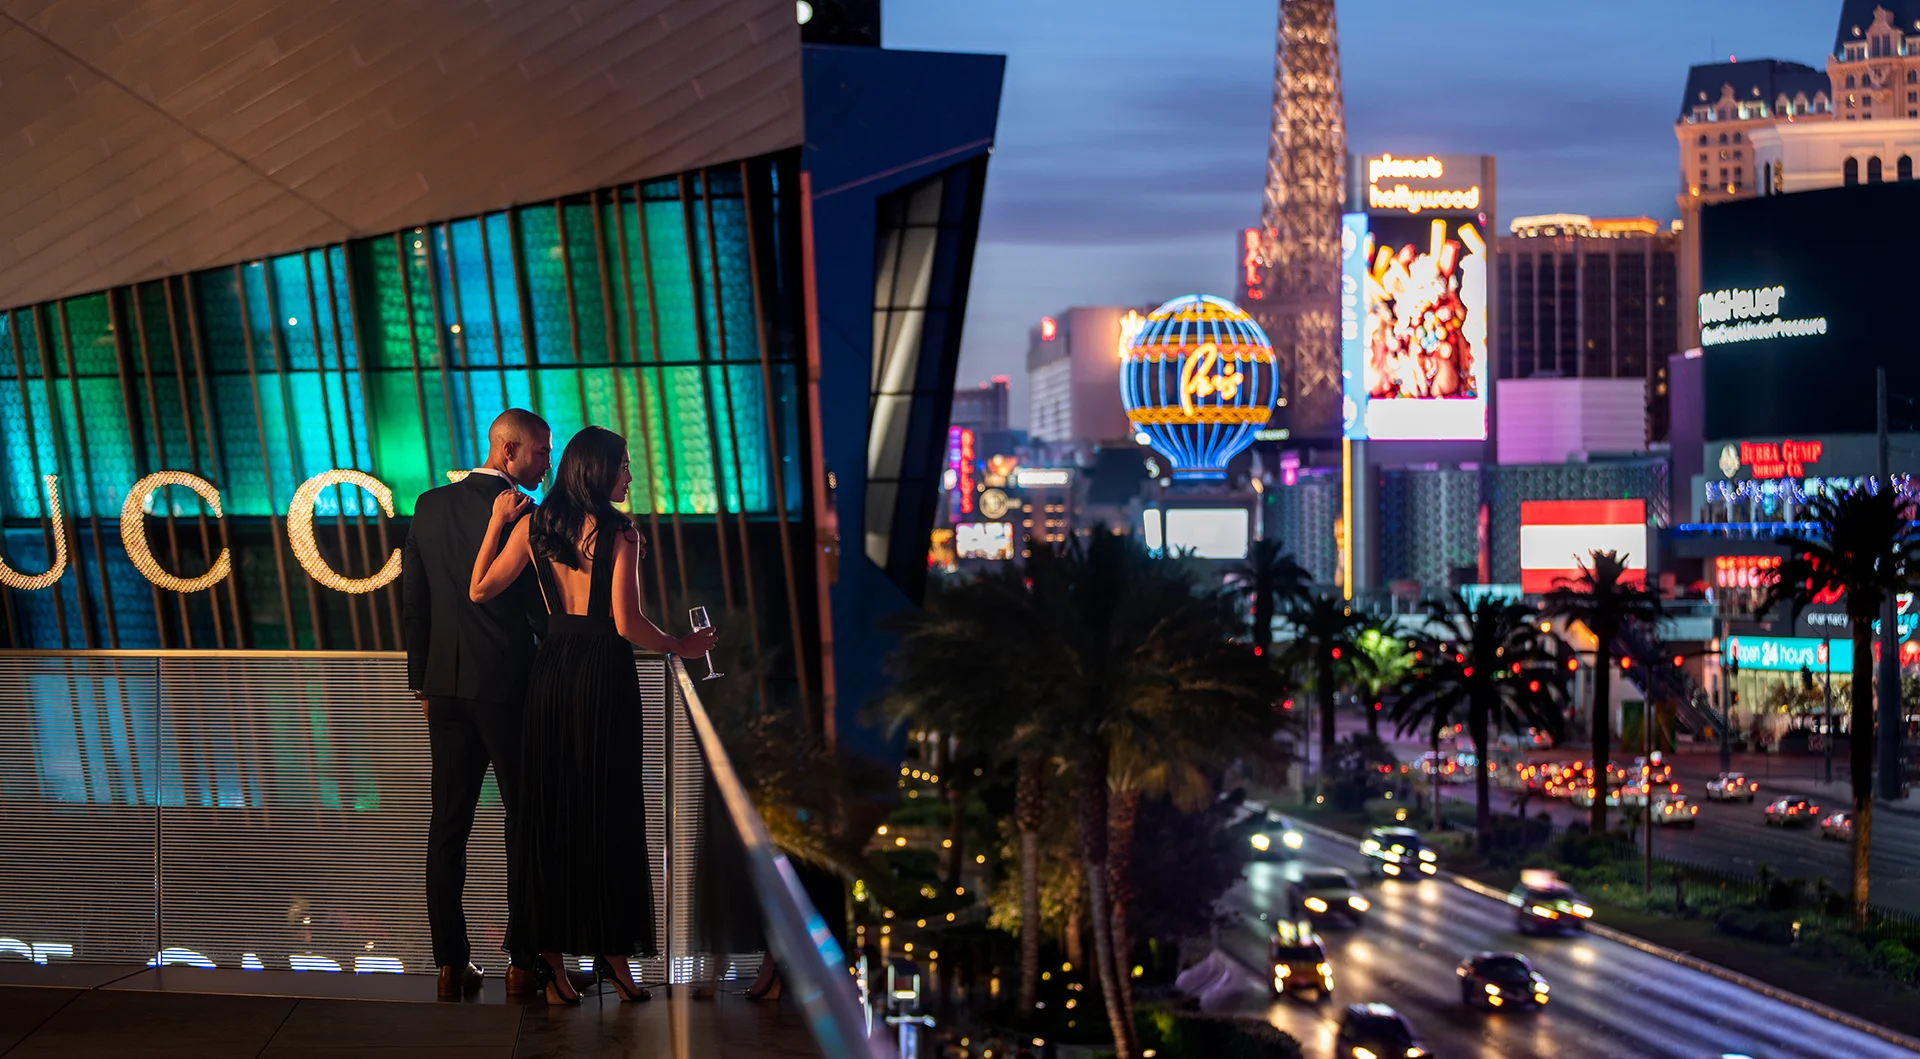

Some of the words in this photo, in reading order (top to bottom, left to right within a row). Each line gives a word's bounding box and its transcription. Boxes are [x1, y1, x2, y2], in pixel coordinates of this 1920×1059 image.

[1369, 153, 1443, 183] planet
[1369, 184, 1480, 213] hollywood
[1740, 441, 1780, 464] BUBBA
[1782, 439, 1822, 463] GUMP
[1752, 461, 1785, 478] SHRIMP
[1739, 644, 1760, 664] open
[1762, 641, 1778, 666] 24
[1780, 643, 1814, 665] hours
